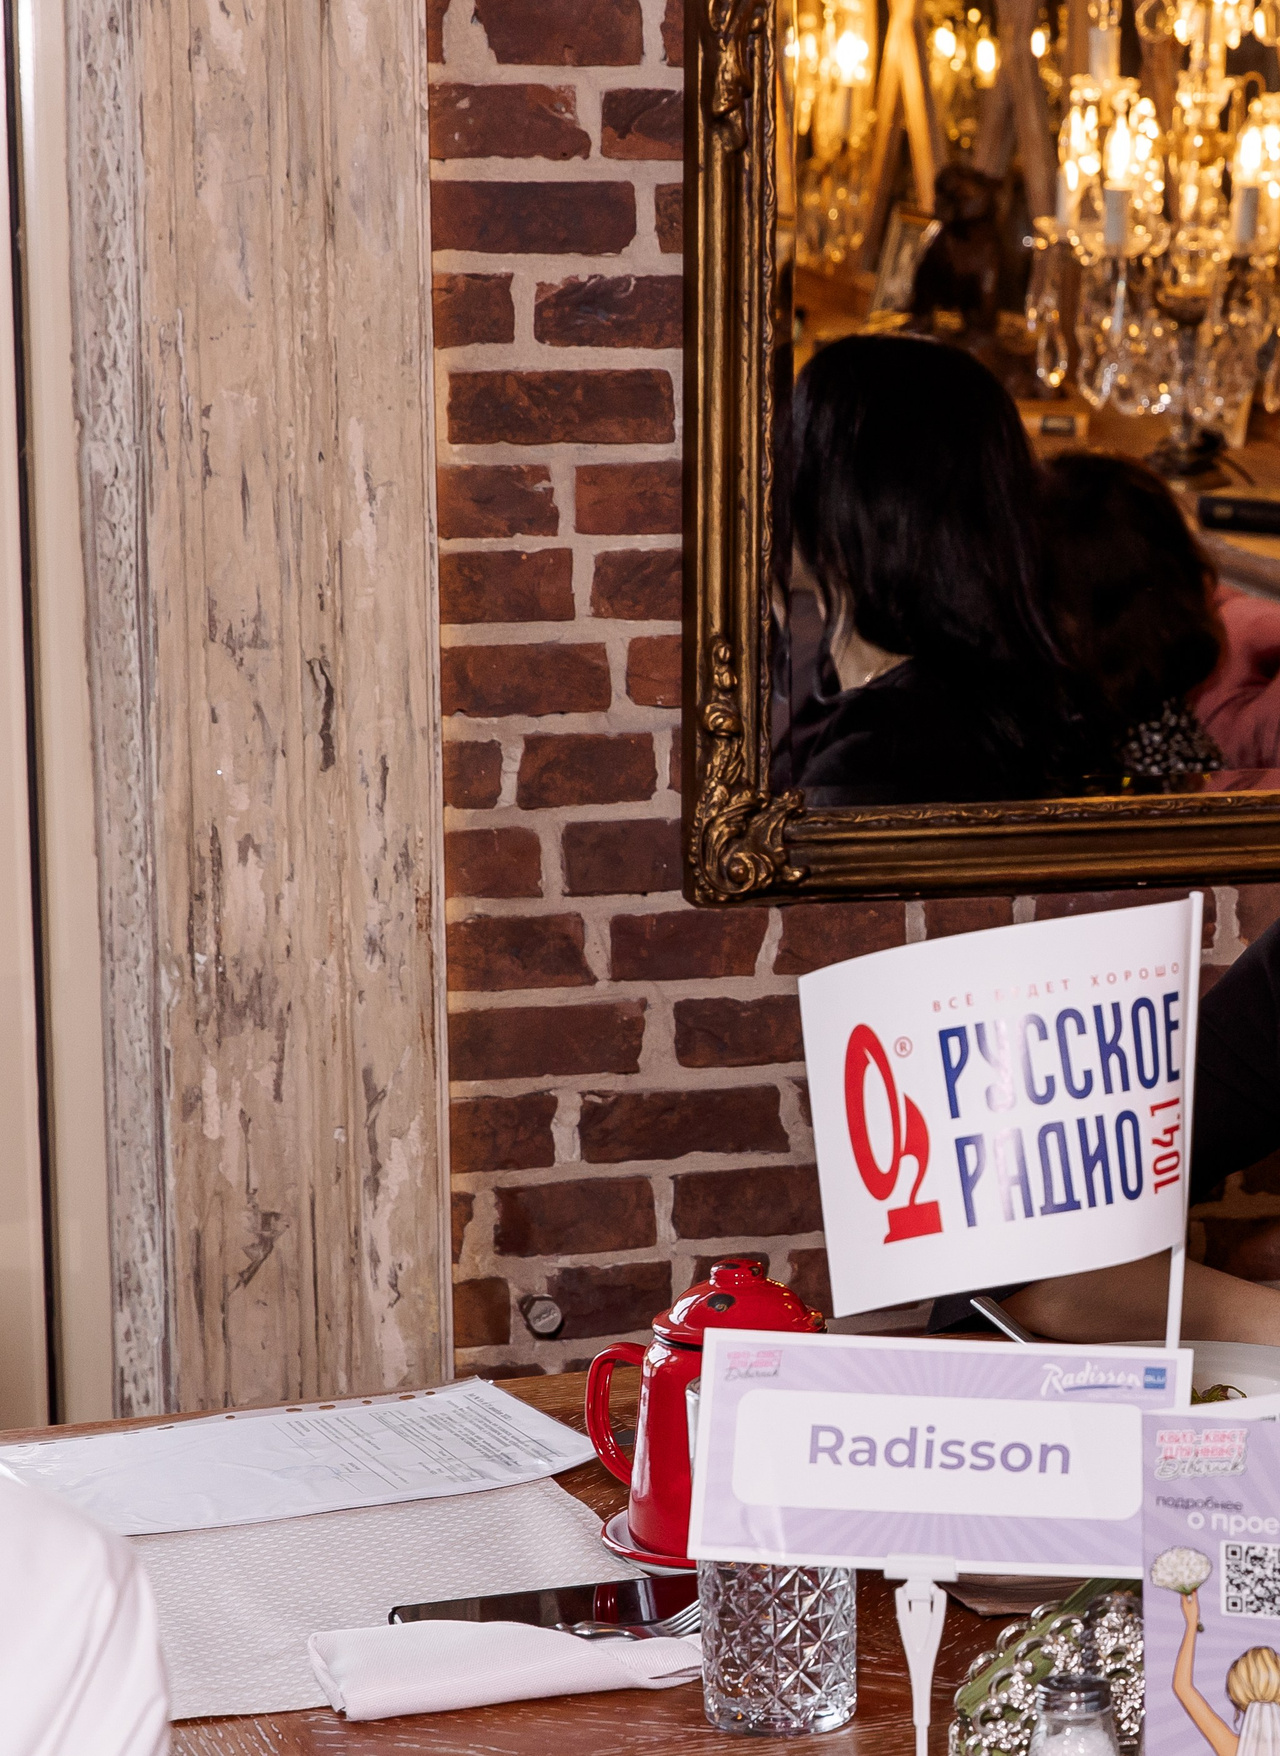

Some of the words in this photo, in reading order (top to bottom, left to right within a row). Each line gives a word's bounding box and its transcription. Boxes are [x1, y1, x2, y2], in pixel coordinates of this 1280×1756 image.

[1091, 962, 1180, 987] ХОРОШО
[938, 991, 1180, 1119] РУССКОЕ
[1150, 1097, 1181, 1195] 104.1
[954, 1110, 1144, 1228] РАДИО
[1040, 1361, 1141, 1396] Radisson
[807, 1423, 1071, 1475] Radisson
[1155, 1495, 1244, 1511] подробнее
[1186, 1511, 1206, 1530] о
